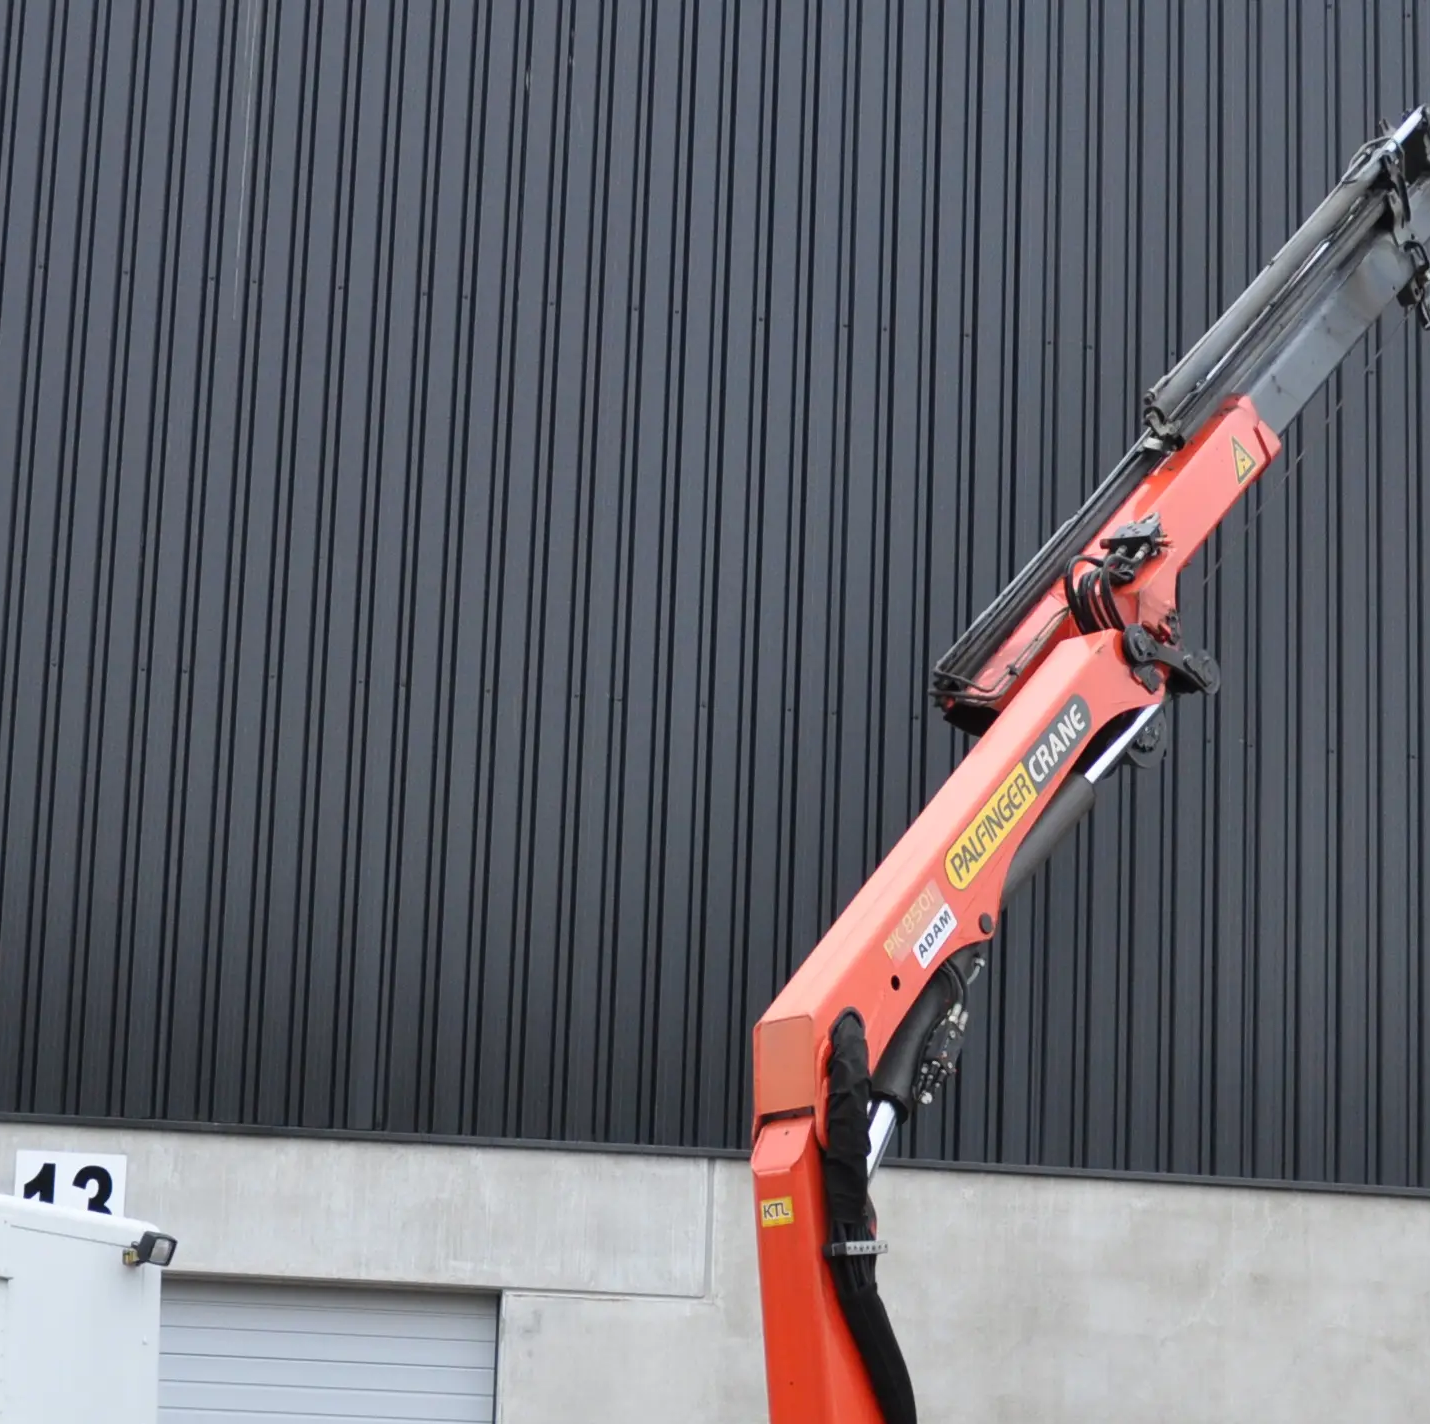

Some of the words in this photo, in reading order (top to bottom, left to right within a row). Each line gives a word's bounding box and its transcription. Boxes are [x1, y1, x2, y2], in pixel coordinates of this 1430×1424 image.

[950, 772, 1032, 883] PALFINGER
[1028, 704, 1086, 783] CRANE
[883, 928, 906, 960] PK
[918, 910, 952, 959] ADAM
[763, 1202, 789, 1219] KTL
